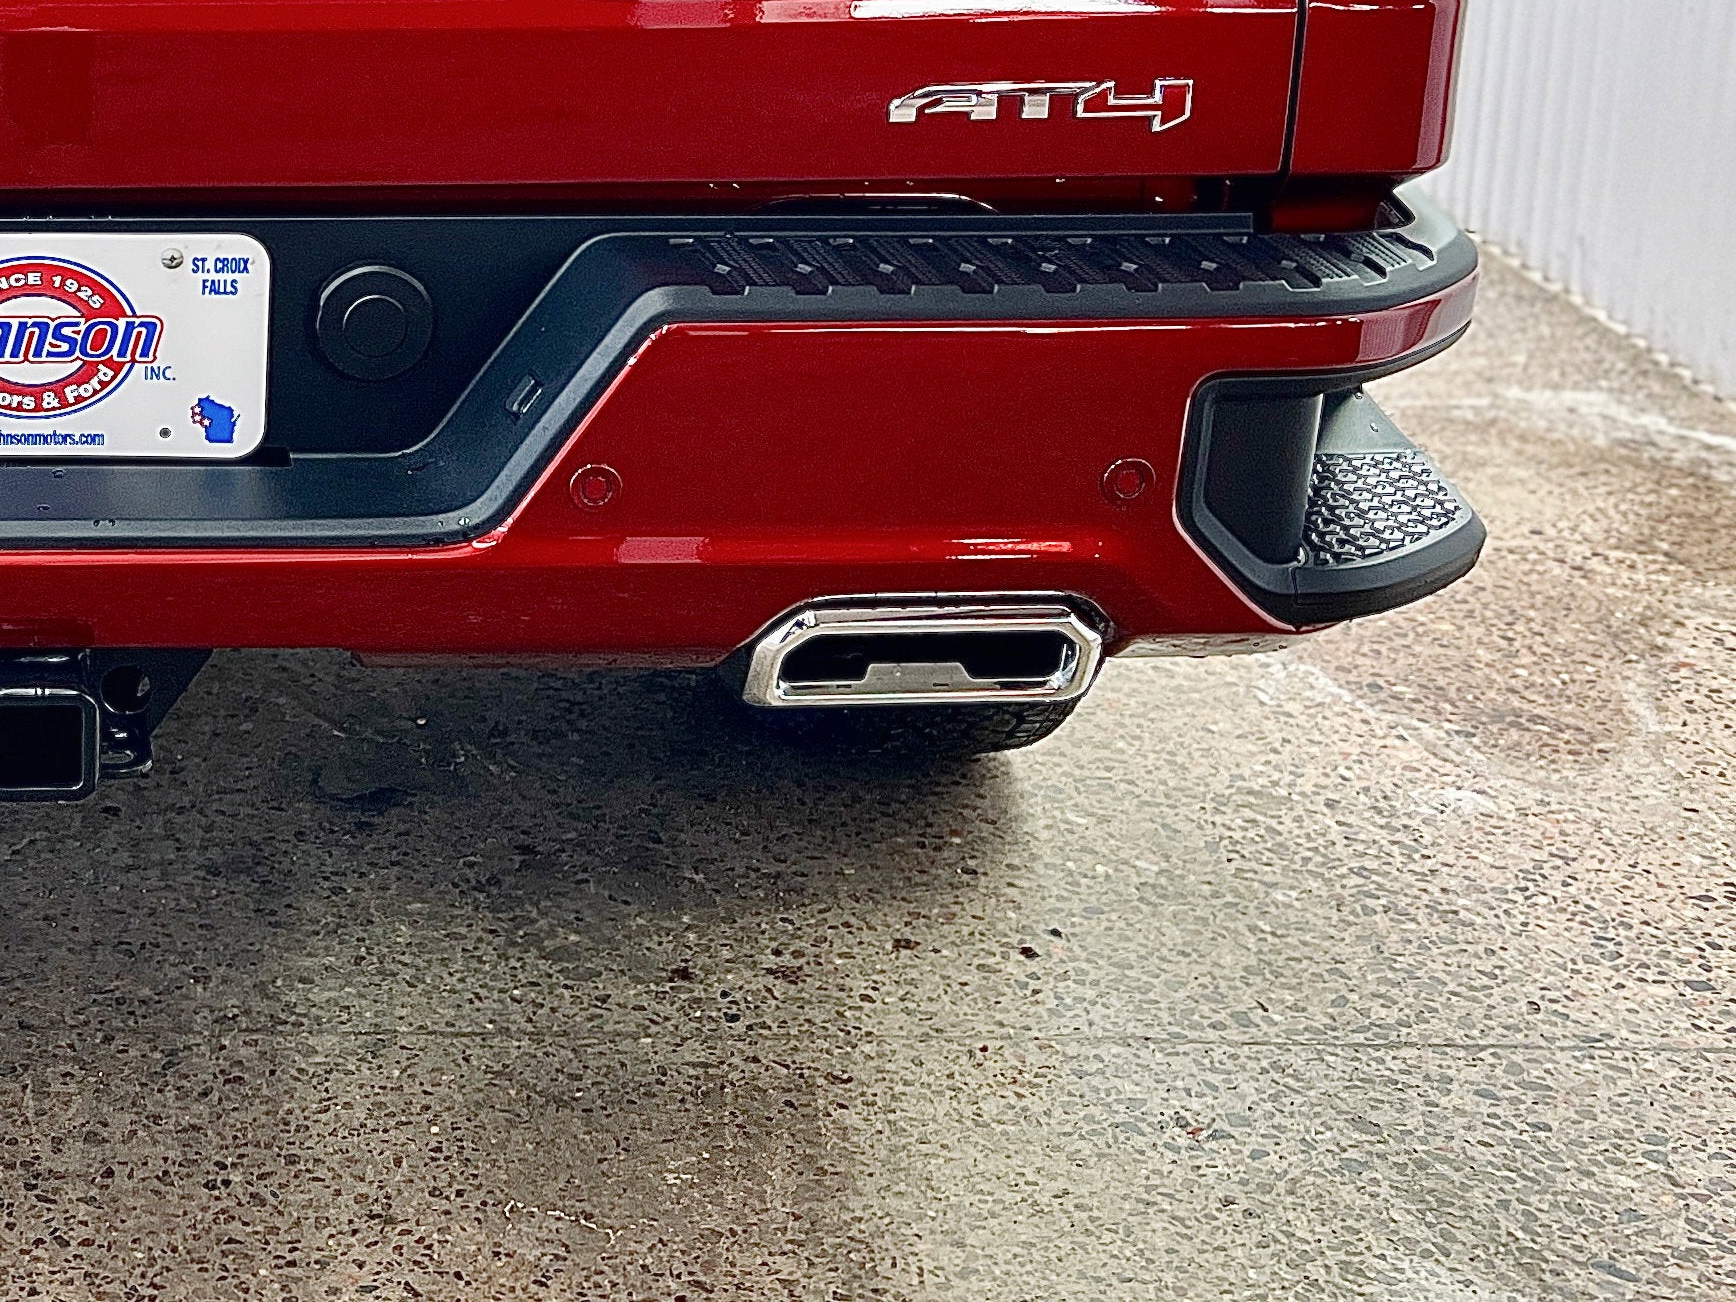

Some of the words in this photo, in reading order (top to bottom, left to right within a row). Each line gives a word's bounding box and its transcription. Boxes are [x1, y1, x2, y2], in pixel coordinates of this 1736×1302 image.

[888, 78, 1194, 132] AT4
[191, 256, 211, 274] ST.
[213, 256, 250, 274] CROIX
[51, 275, 105, 309] 1925
[201, 278, 239, 296] FALLS
[41, 391, 62, 409] &
[64, 364, 115, 404] Ford
[144, 366, 177, 381] INC.
